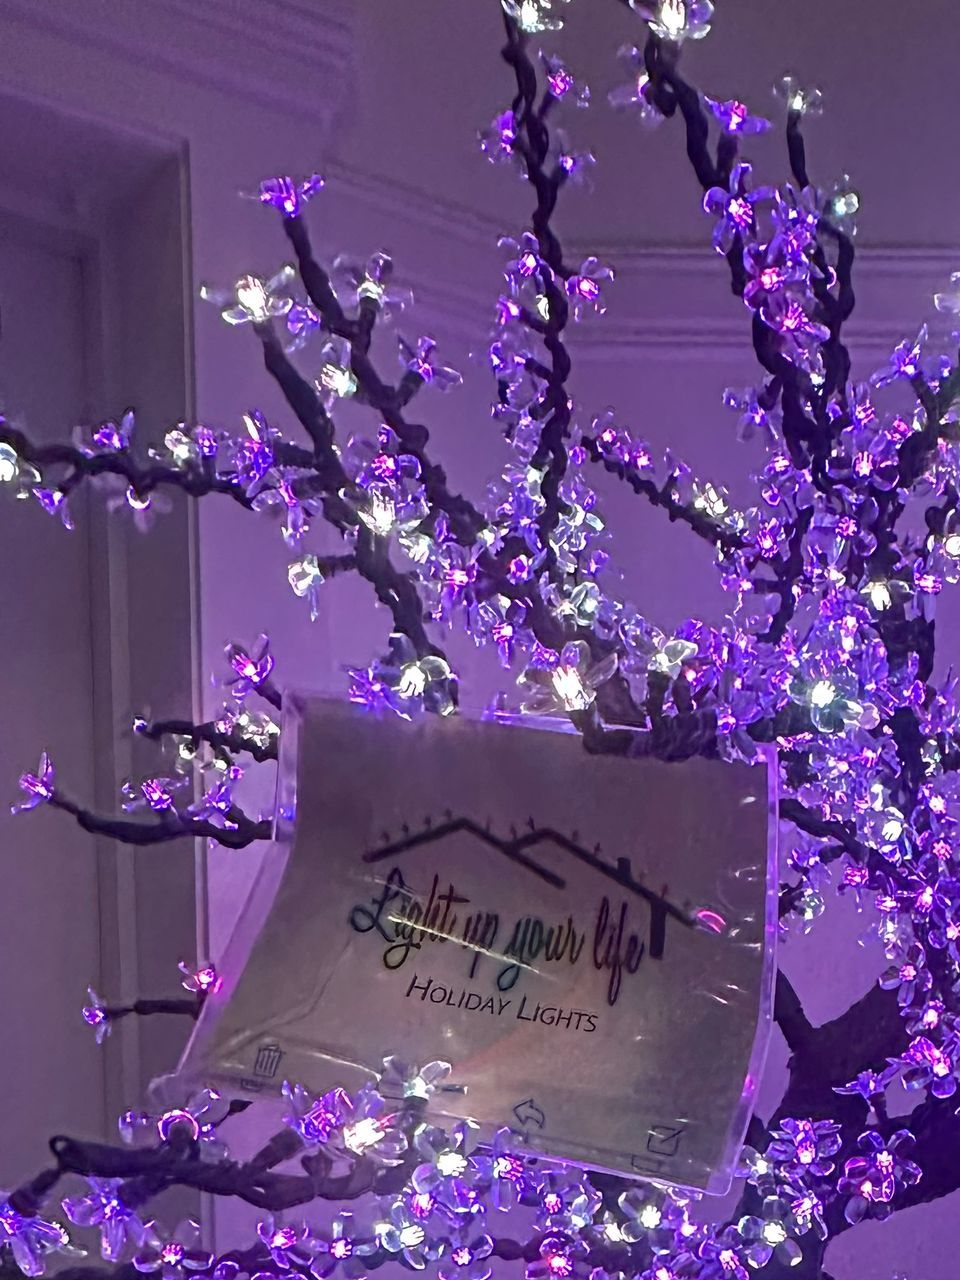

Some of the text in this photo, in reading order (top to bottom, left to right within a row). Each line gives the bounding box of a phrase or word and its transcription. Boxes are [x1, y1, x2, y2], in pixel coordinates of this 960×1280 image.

[351, 867, 646, 1006] Light up your life
[405, 974, 599, 1034] HOLIDAY LIGHTS
